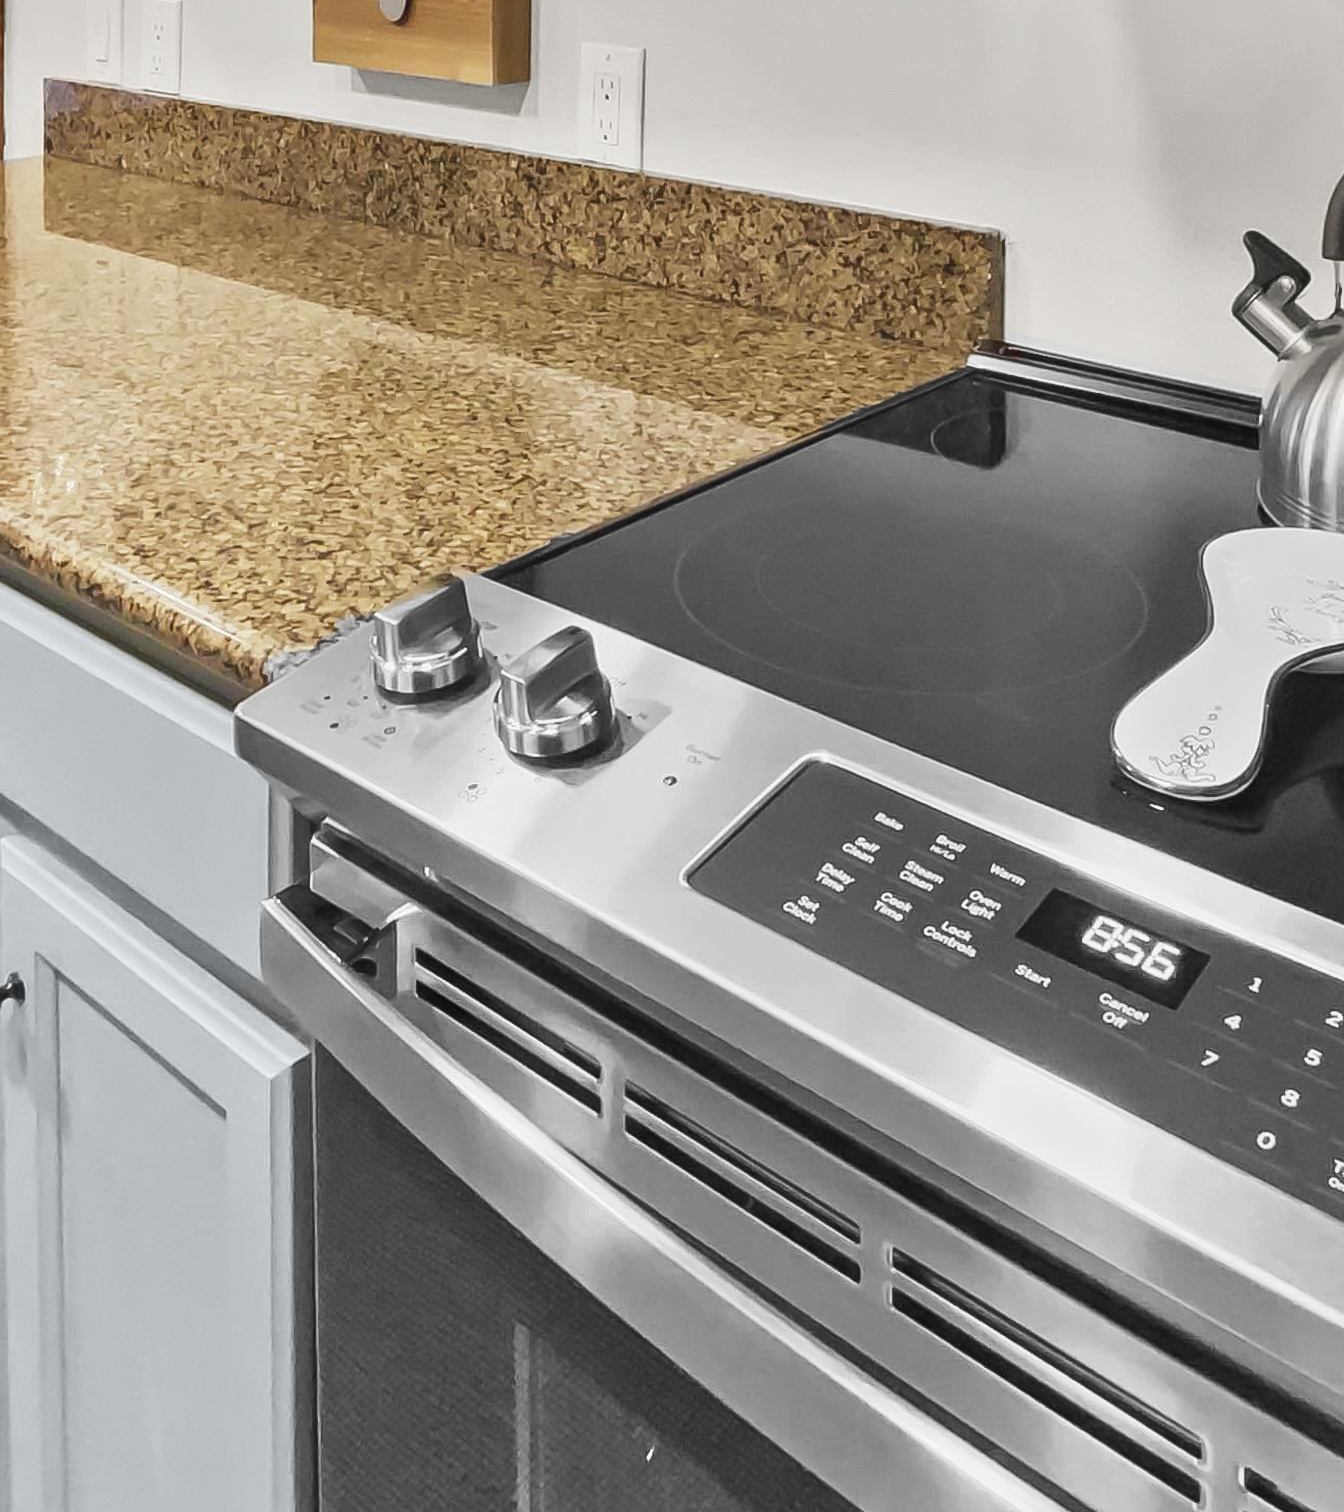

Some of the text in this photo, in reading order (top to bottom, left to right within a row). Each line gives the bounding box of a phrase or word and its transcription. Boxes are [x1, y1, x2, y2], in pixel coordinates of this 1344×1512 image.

[815, 871, 845, 893] Time
[898, 869, 935, 893] Clean
[905, 859, 945, 885] Steam
[989, 861, 1027, 887] Warm
[797, 894, 820, 913] Set
[873, 899, 905, 923] Time
[880, 891, 914, 914] Cook
[960, 898, 996, 921] Light
[968, 889, 1002, 912] Oven
[782, 900, 818, 925] Clock
[923, 925, 978, 958] Controls
[940, 919, 973, 943] Lock
[1014, 963, 1052, 988] Start
[1247, 976, 1263, 994] 1
[1098, 992, 1150, 1023] Cancel
[1324, 1009, 1344, 1029] 2
[1102, 1011, 1129, 1029] Off
[1223, 1014, 1243, 1031] 4
[1200, 1049, 1220, 1067] 7
[1303, 1048, 1324, 1067] 5
[1280, 1088, 1301, 1108] 8
[1256, 1130, 1277, 1150] 0
